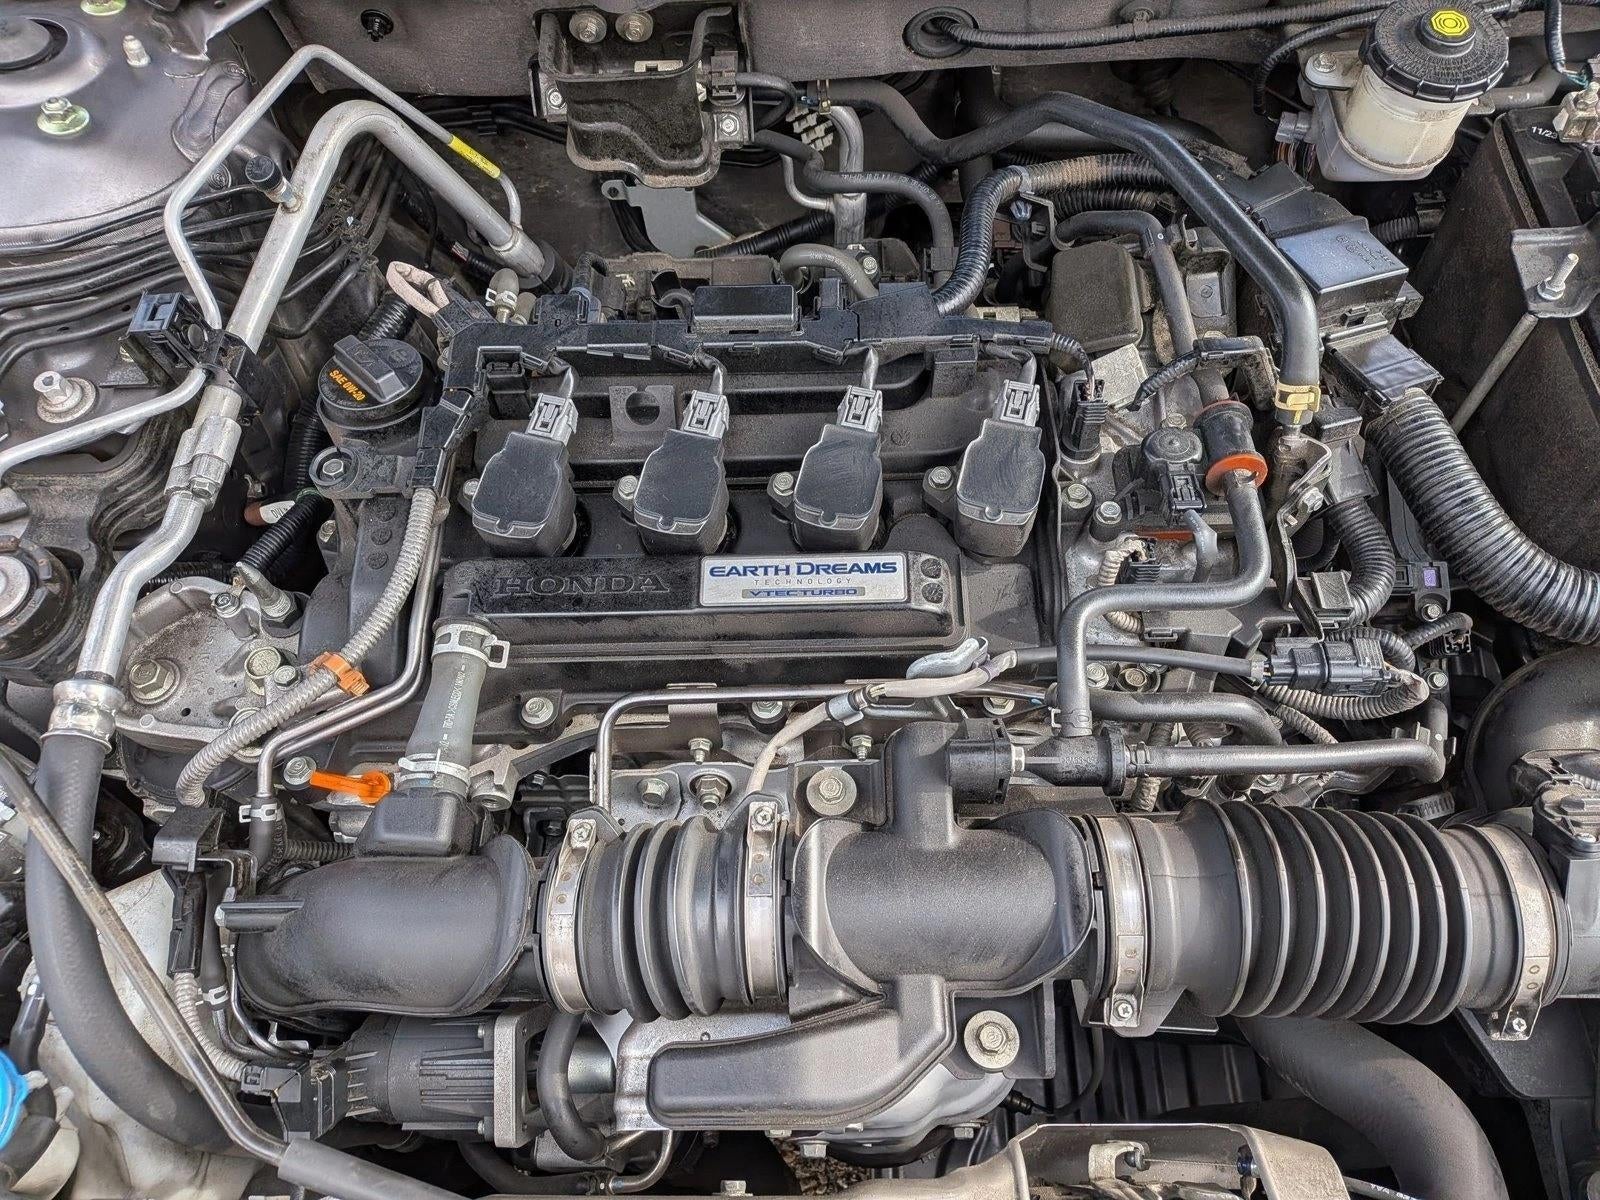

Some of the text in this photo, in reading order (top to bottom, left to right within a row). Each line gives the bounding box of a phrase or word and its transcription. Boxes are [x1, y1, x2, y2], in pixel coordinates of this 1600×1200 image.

[1531, 126, 1558, 139] 11/23
[329, 369, 348, 384] SAE
[343, 381, 366, 401] 0W-20
[709, 562, 897, 577] EARTH DREAMS
[492, 574, 670, 596] HONDA
[754, 578, 852, 586] TECHNOLOGY
